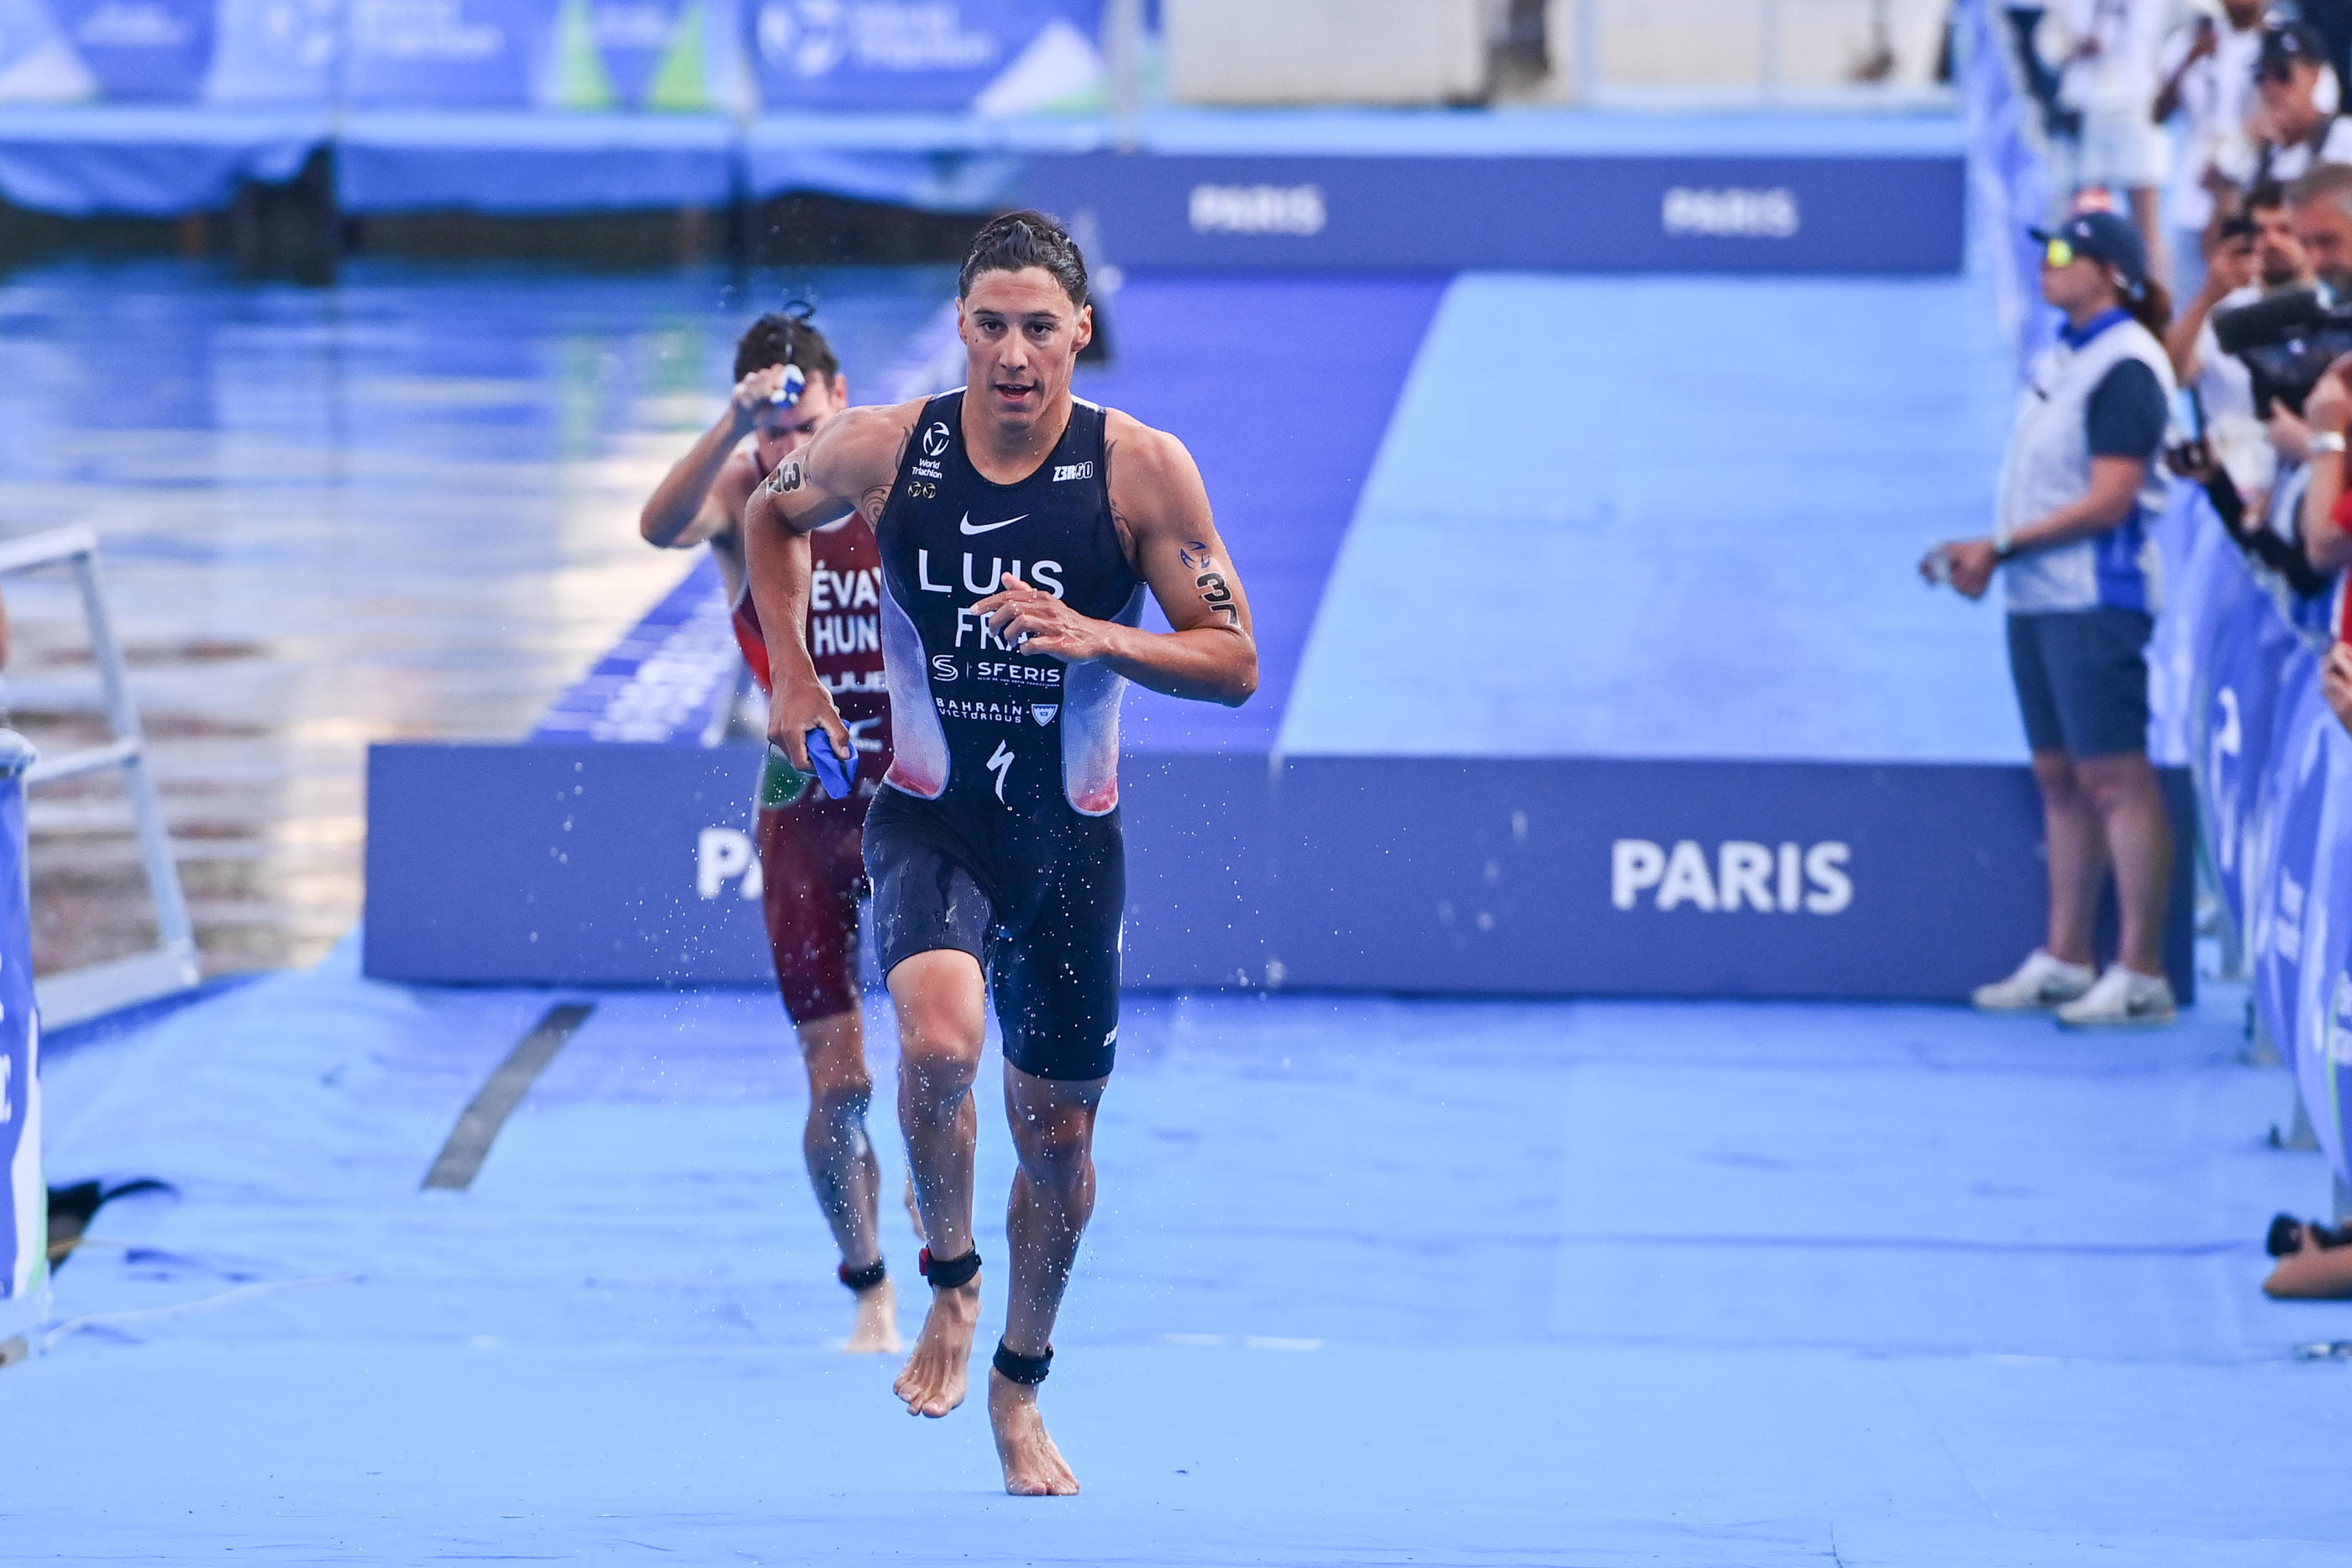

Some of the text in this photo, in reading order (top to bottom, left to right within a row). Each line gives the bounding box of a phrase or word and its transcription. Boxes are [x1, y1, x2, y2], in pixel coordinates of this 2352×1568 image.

[911, 466, 942, 480] Triathlon
[919, 458, 941, 469] World
[918, 548, 1064, 600] LUIS
[813, 614, 879, 658] HUN
[935, 697, 1022, 716] BAHRAIN
[938, 708, 1021, 723] VICTORIOUS
[1609, 838, 1854, 915] PARIS
